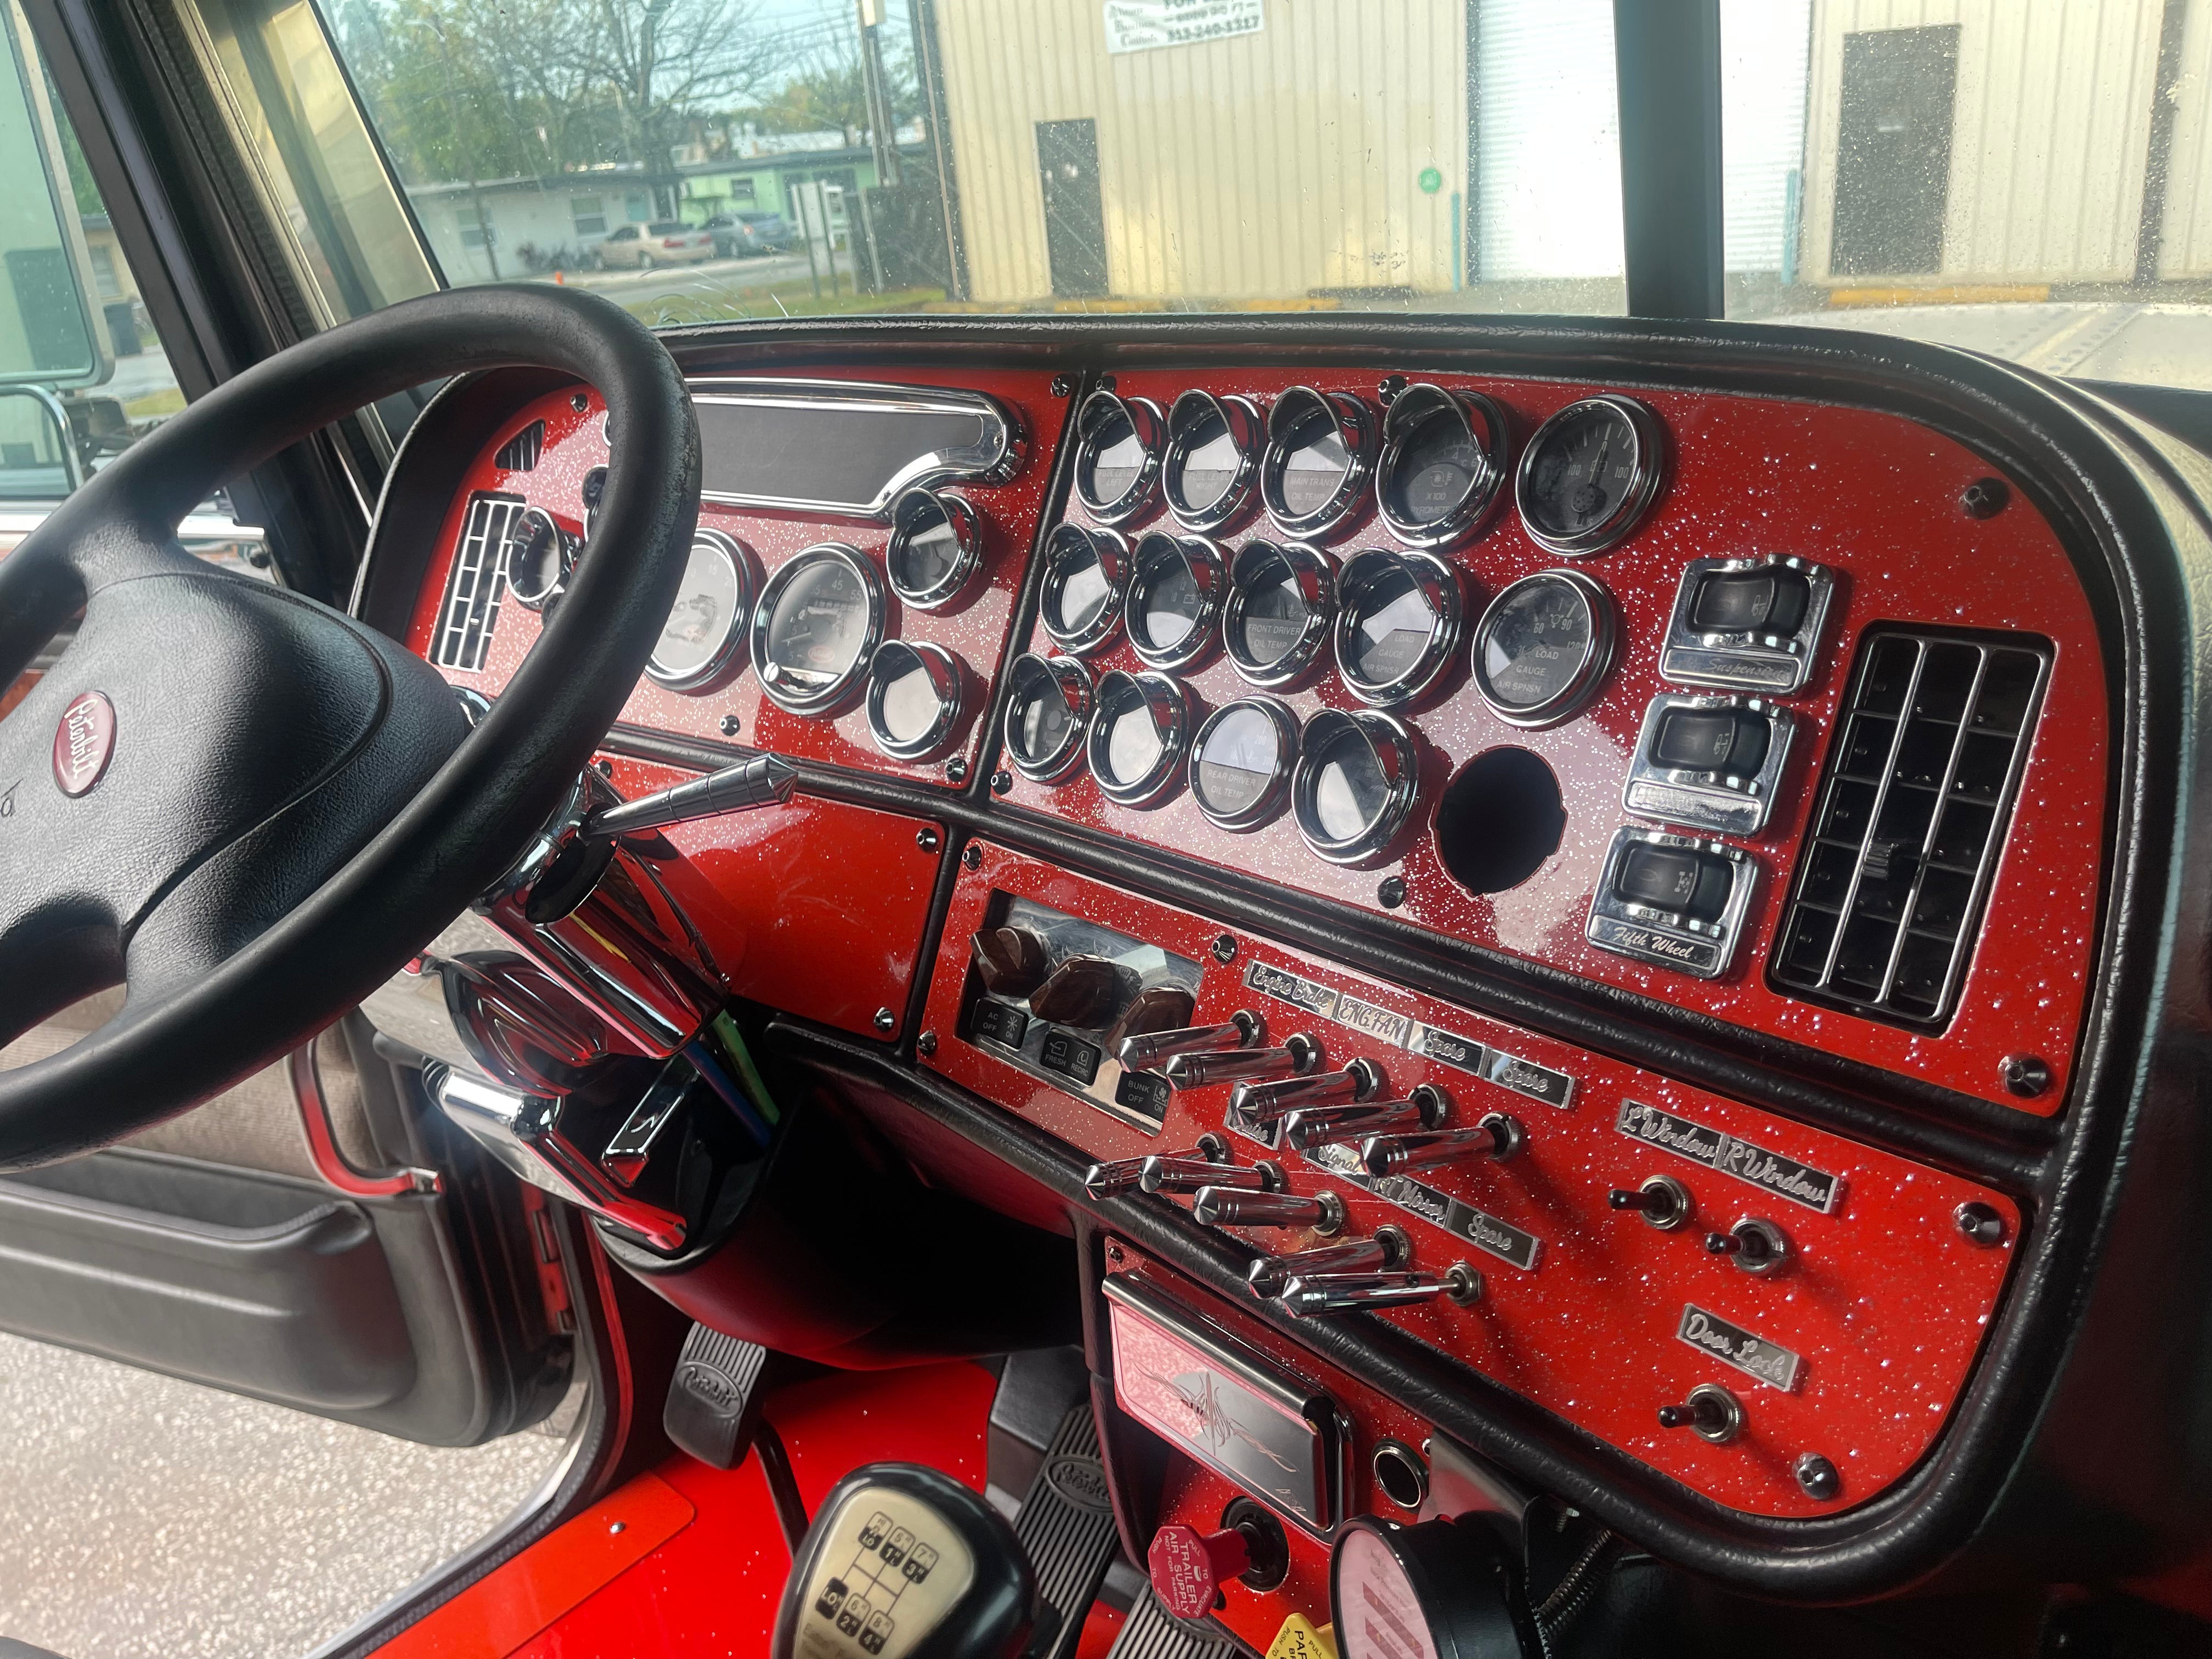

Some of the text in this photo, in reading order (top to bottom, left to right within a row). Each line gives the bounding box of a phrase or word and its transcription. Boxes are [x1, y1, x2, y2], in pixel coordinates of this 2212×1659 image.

[1098, 469, 1113, 477] FUEL
[1567, 465, 1581, 476] 100
[1615, 467, 1629, 478] 100
[1188, 473, 1229, 481] FUEL LEVEL
[1290, 476, 1334, 487] MAIN TRANS
[1196, 482, 1217, 490] RIGHT
[1291, 493, 1324, 501] OIL TEMP
[831, 579, 844, 590] 45
[850, 590, 862, 601] 55
[1248, 624, 1301, 635] FRONT DRIVER
[1533, 623, 1544, 634] 60
[1561, 619, 1572, 631] 90
[1395, 634, 1414, 643] LOAD
[1254, 640, 1287, 650] OIL TEMP
[1379, 649, 1404, 658] GAUGE
[1536, 650, 1559, 660] LOAD
[1363, 663, 1374, 672] AIR
[1516, 665, 1547, 676] GAUGE
[1497, 680, 1541, 693] AIR SPNSN
[64, 698, 101, 780] Peterbilt
[1207, 770, 1255, 786] REAR DRIVER
[1211, 786, 1244, 799] OIL TEMP
[1612, 926, 1695, 958] Fifth Wheel
[1253, 964, 1328, 1009] Engine Brake
[988, 1012, 998, 1020] AC
[983, 1022, 997, 1031] OFF
[1370, 1010, 1406, 1041] FAN
[1006, 1031, 1013, 1040] ON
[1424, 1029, 1466, 1062] Spare
[1045, 1054, 1066, 1067] FRESH
[1070, 1063, 1089, 1077] RECIRC
[1502, 1059, 1549, 1093] Spare
[1128, 1079, 1150, 1093] BUNK
[1128, 1093, 1144, 1104] OFF
[1154, 1104, 1164, 1114] ON
[1234, 1122, 1269, 1142] uise
[1621, 1105, 1718, 1159] L Window
[1317, 1144, 1361, 1176] Signal
[1723, 1141, 1827, 1203] R Window
[1468, 1213, 1512, 1251] Spare
[1686, 1313, 1734, 1355] Door
[918, 1548, 927, 1559] 7
[1152, 1536, 1175, 1611] PUSH TO SUPPLY
[1169, 1531, 1190, 1614] AIR SUPPLY
[1180, 1542, 1198, 1604] TRAILER
[1188, 1539, 1212, 1617] PULL TO EVACUATE
[1171, 1577, 1181, 1611] PARKING
[840, 1615, 850, 1628] 2
[864, 1634, 873, 1645] 4
[1272, 1626, 1290, 1657] PUSH TO
